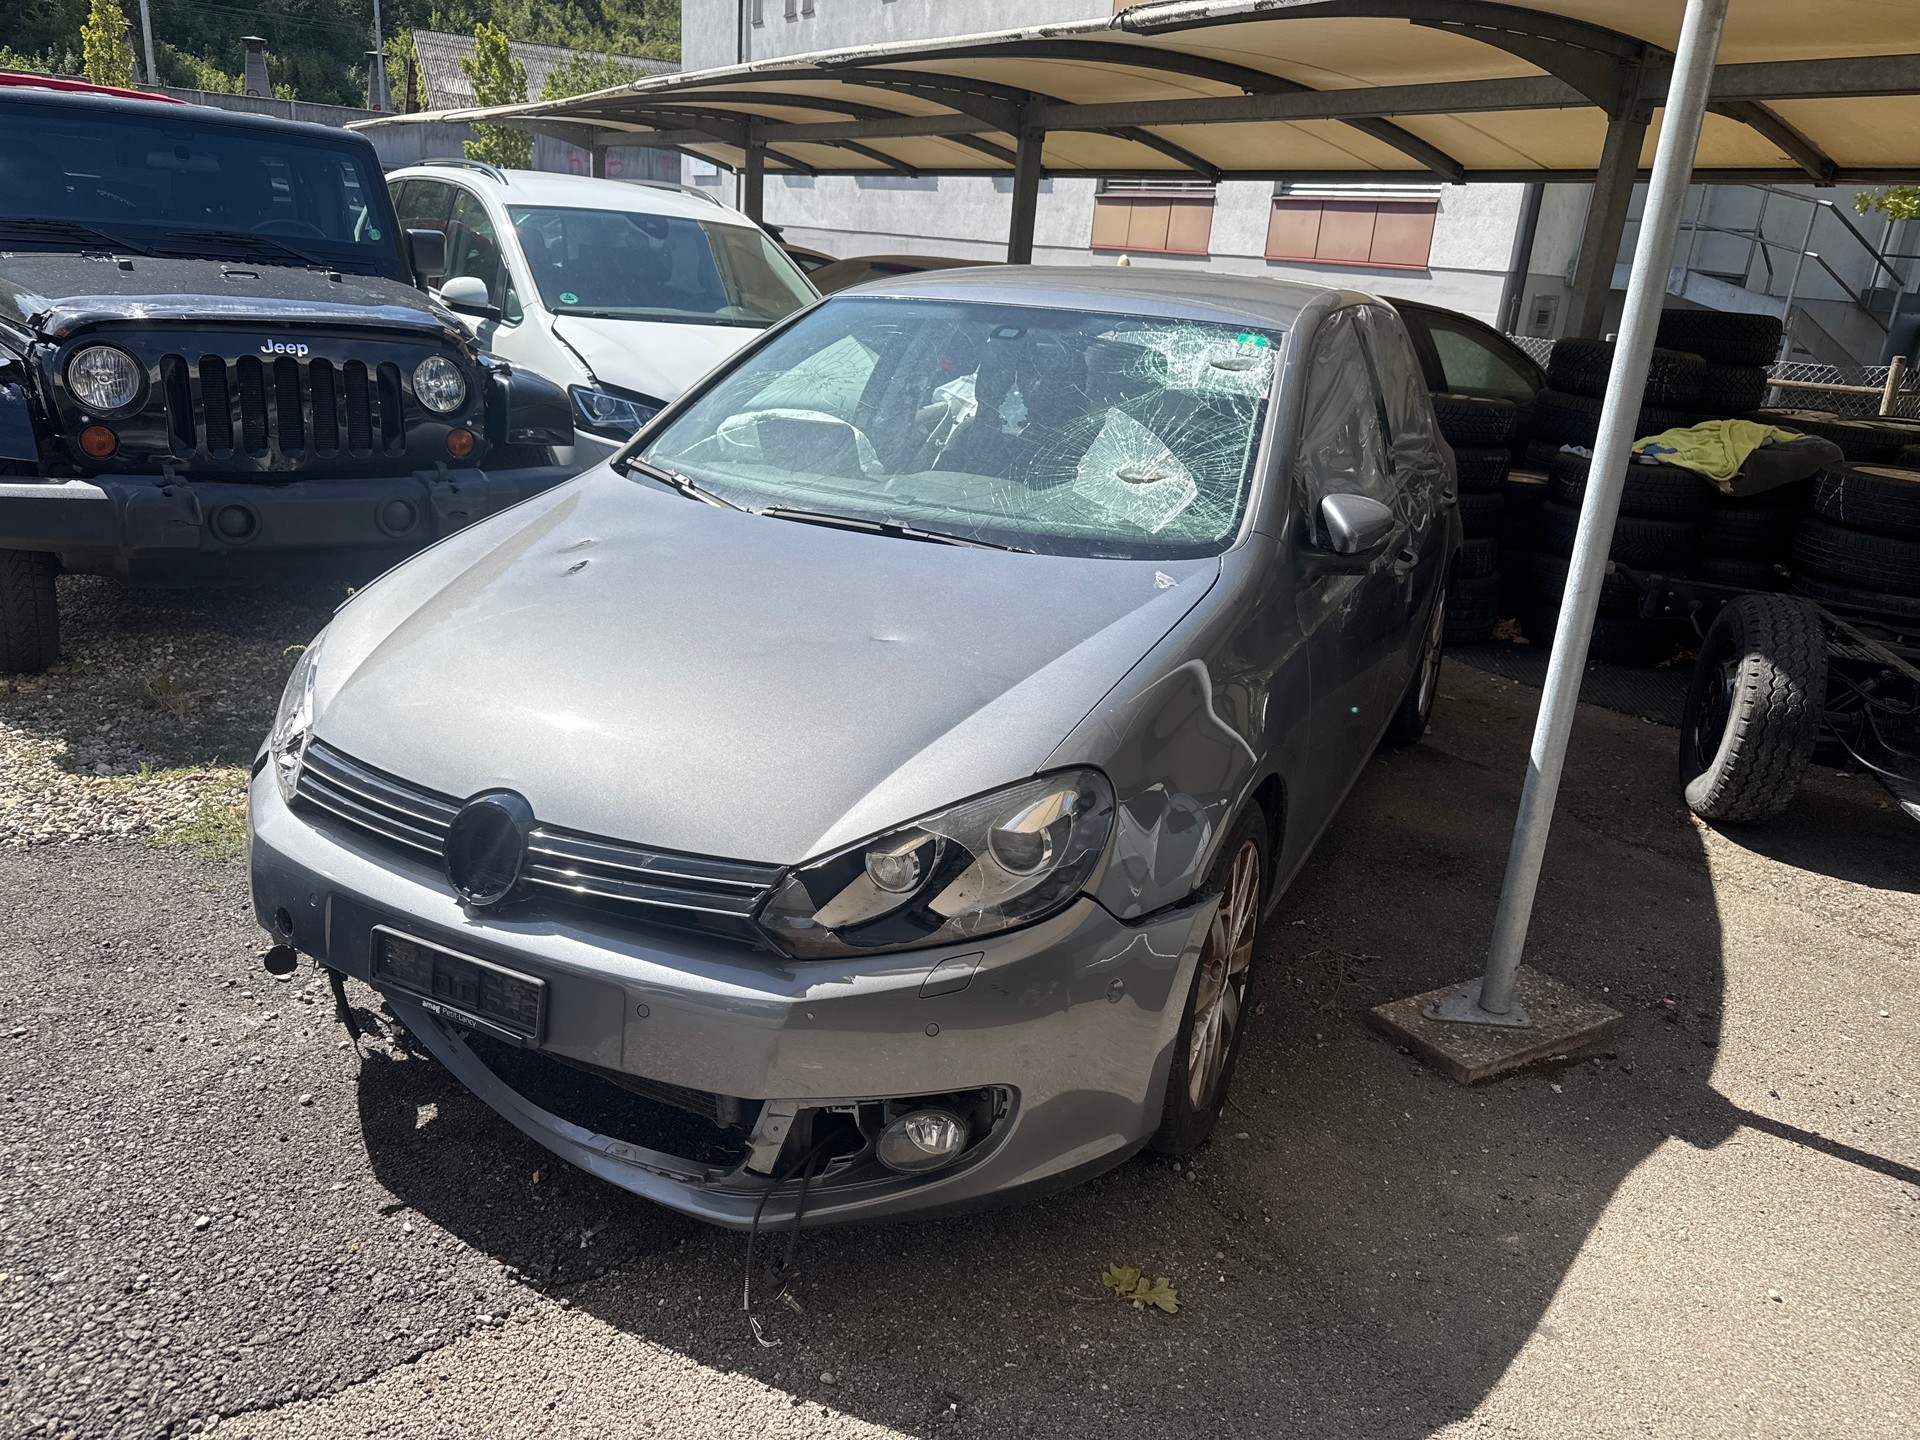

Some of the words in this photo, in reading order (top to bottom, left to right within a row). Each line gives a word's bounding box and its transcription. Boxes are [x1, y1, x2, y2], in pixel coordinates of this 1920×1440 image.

[260, 338, 309, 357] Jeep
[422, 1000, 441, 1014] amag
[442, 1007, 477, 1028] Petit-Lancy
